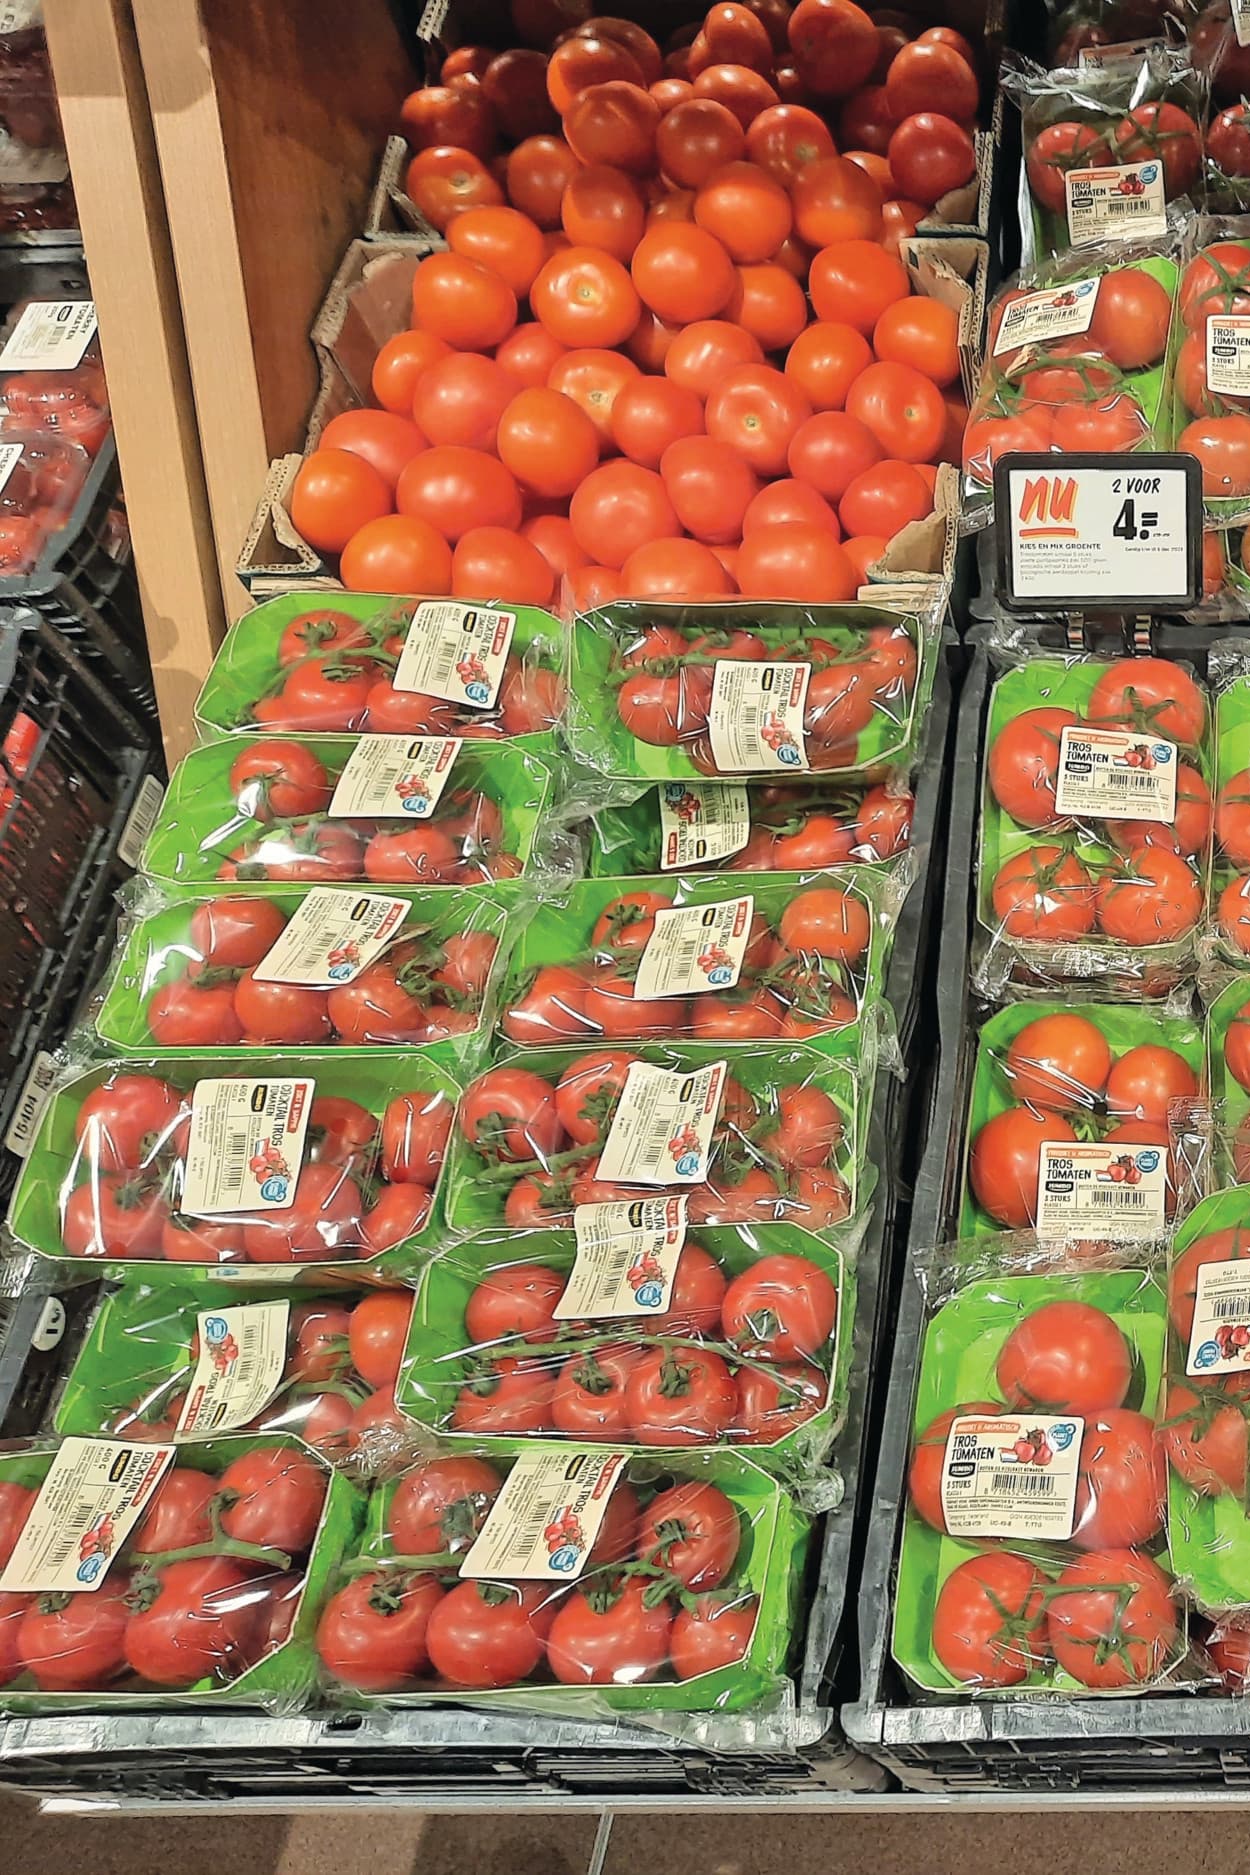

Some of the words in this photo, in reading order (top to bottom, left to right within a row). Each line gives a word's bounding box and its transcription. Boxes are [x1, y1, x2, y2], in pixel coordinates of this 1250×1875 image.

[1212, 327, 1235, 337] TROS
[1112, 478, 1121, 493] 2
[1127, 477, 1161, 494] VOOR
[1067, 741, 1092, 752] TROS
[266, 1084, 280, 1117] TOMATEN
[276, 1084, 292, 1122] COCKTAIL
[14, 1094, 38, 1141] 15404
[271, 1124, 285, 1147] TROS
[1046, 1168, 1092, 1180] TOMATEN
[1047, 1158, 1073, 1169] TROS
[651, 1235, 664, 1257] TROS
[953, 1435, 977, 1448] TROS
[951, 1447, 995, 1461] TOMATEN
[118, 1451, 145, 1489] TOMATEN
[126, 1450, 155, 1495] COCKTAIL
[111, 1495, 131, 1521] TROS
[572, 1491, 586, 1513] TROS
